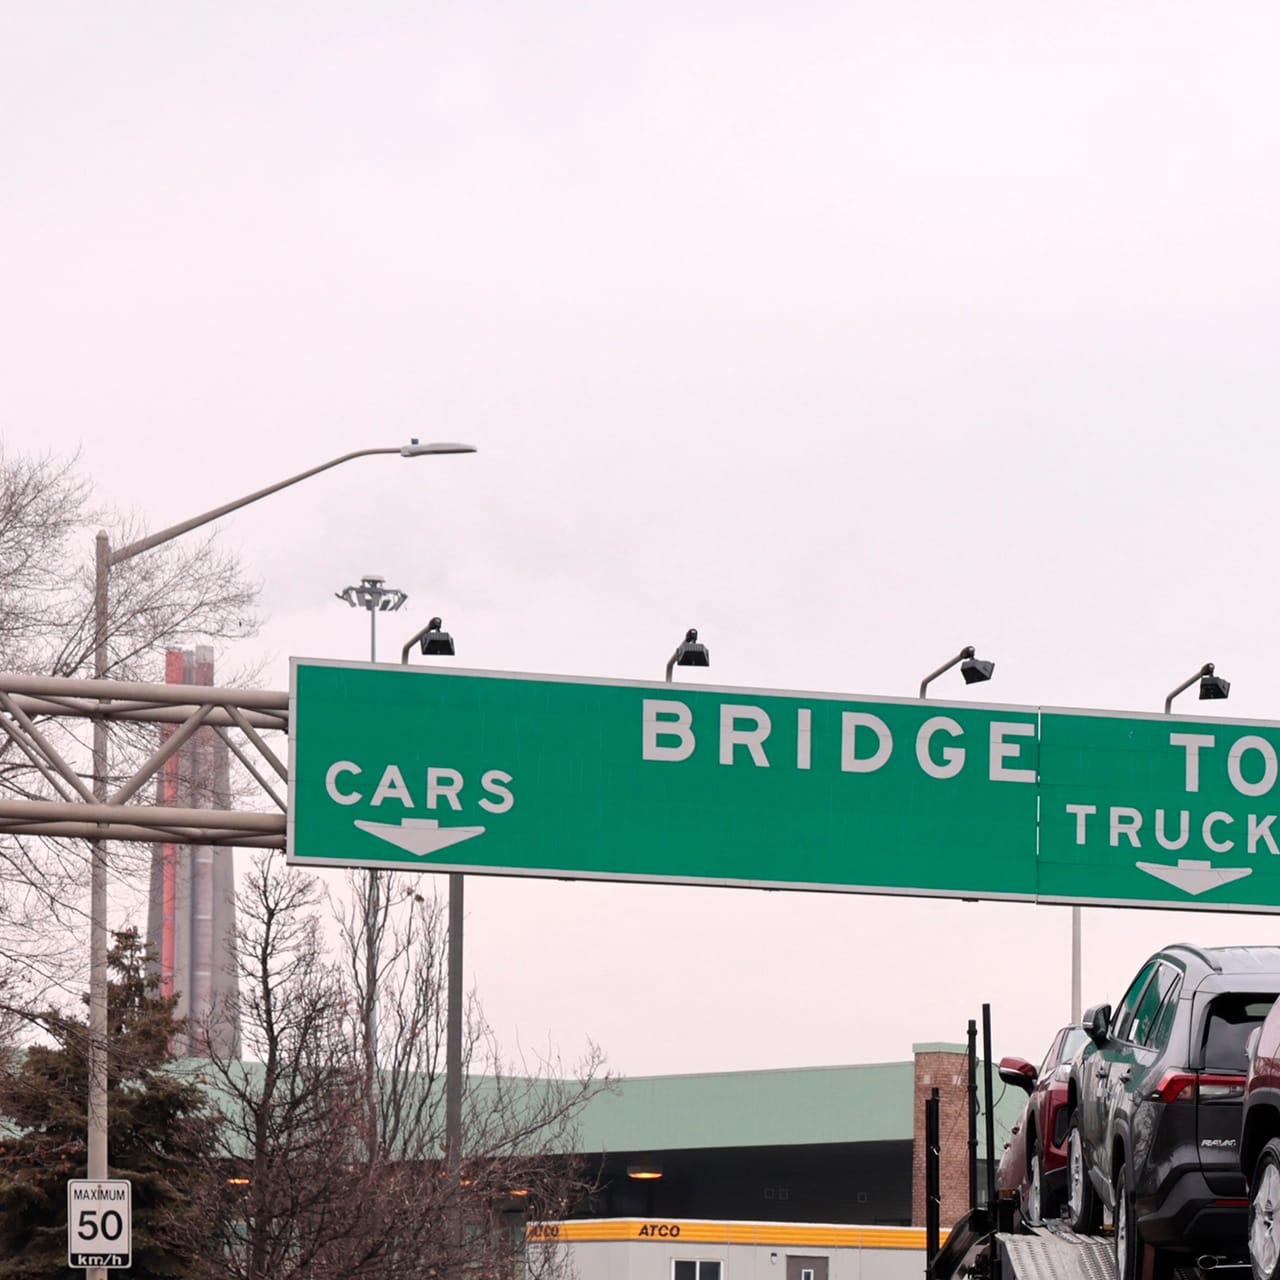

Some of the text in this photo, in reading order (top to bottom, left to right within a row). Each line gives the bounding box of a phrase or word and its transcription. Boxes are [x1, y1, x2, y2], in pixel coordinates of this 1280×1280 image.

[642, 699, 1037, 783] BRIDGE
[1170, 733, 1278, 797] TO
[325, 760, 515, 813] CARS
[74, 1189, 126, 1201] MAXIMUM
[78, 1210, 123, 1241] 50
[638, 1225, 681, 1237] ATCO
[78, 1254, 122, 1266] km/h
